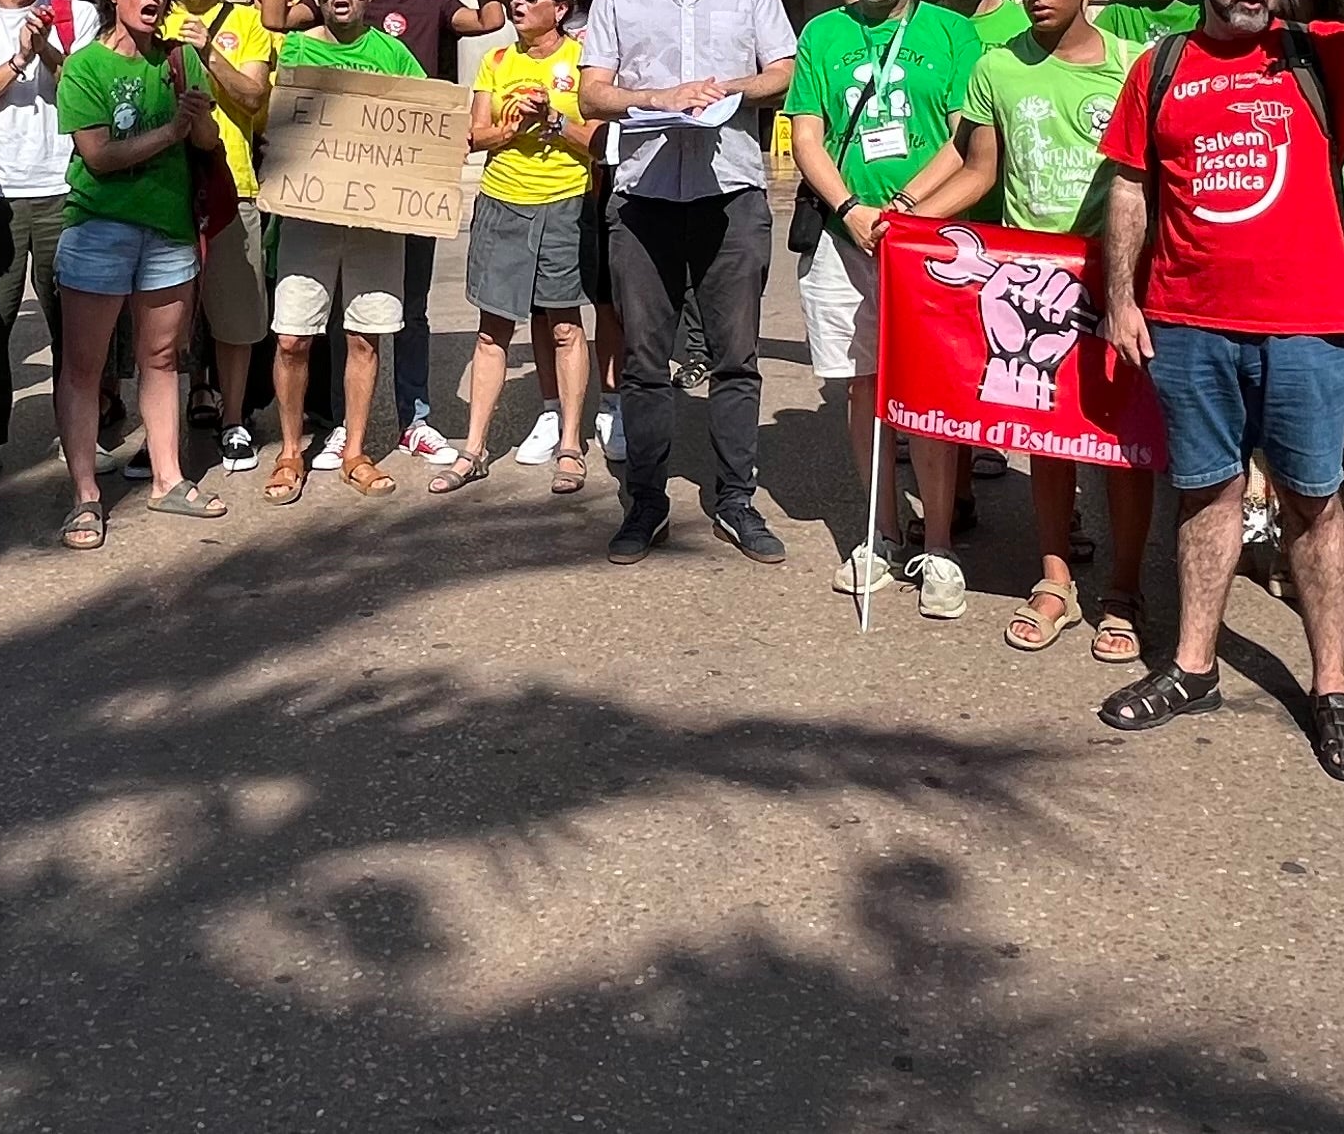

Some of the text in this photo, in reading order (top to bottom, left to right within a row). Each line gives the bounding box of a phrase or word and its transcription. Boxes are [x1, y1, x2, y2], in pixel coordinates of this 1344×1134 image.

[1173, 77, 1212, 101] UGT
[292, 96, 453, 140] EL NOSTRE
[310, 138, 423, 168] ALUMNAT
[1194, 131, 1265, 154] Salvem
[1196, 148, 1268, 173] l'escola
[279, 173, 453, 222] NO ES TOCA
[1191, 169, 1265, 197] pública
[887, 398, 1153, 465] Sindicat d'Estudiants
